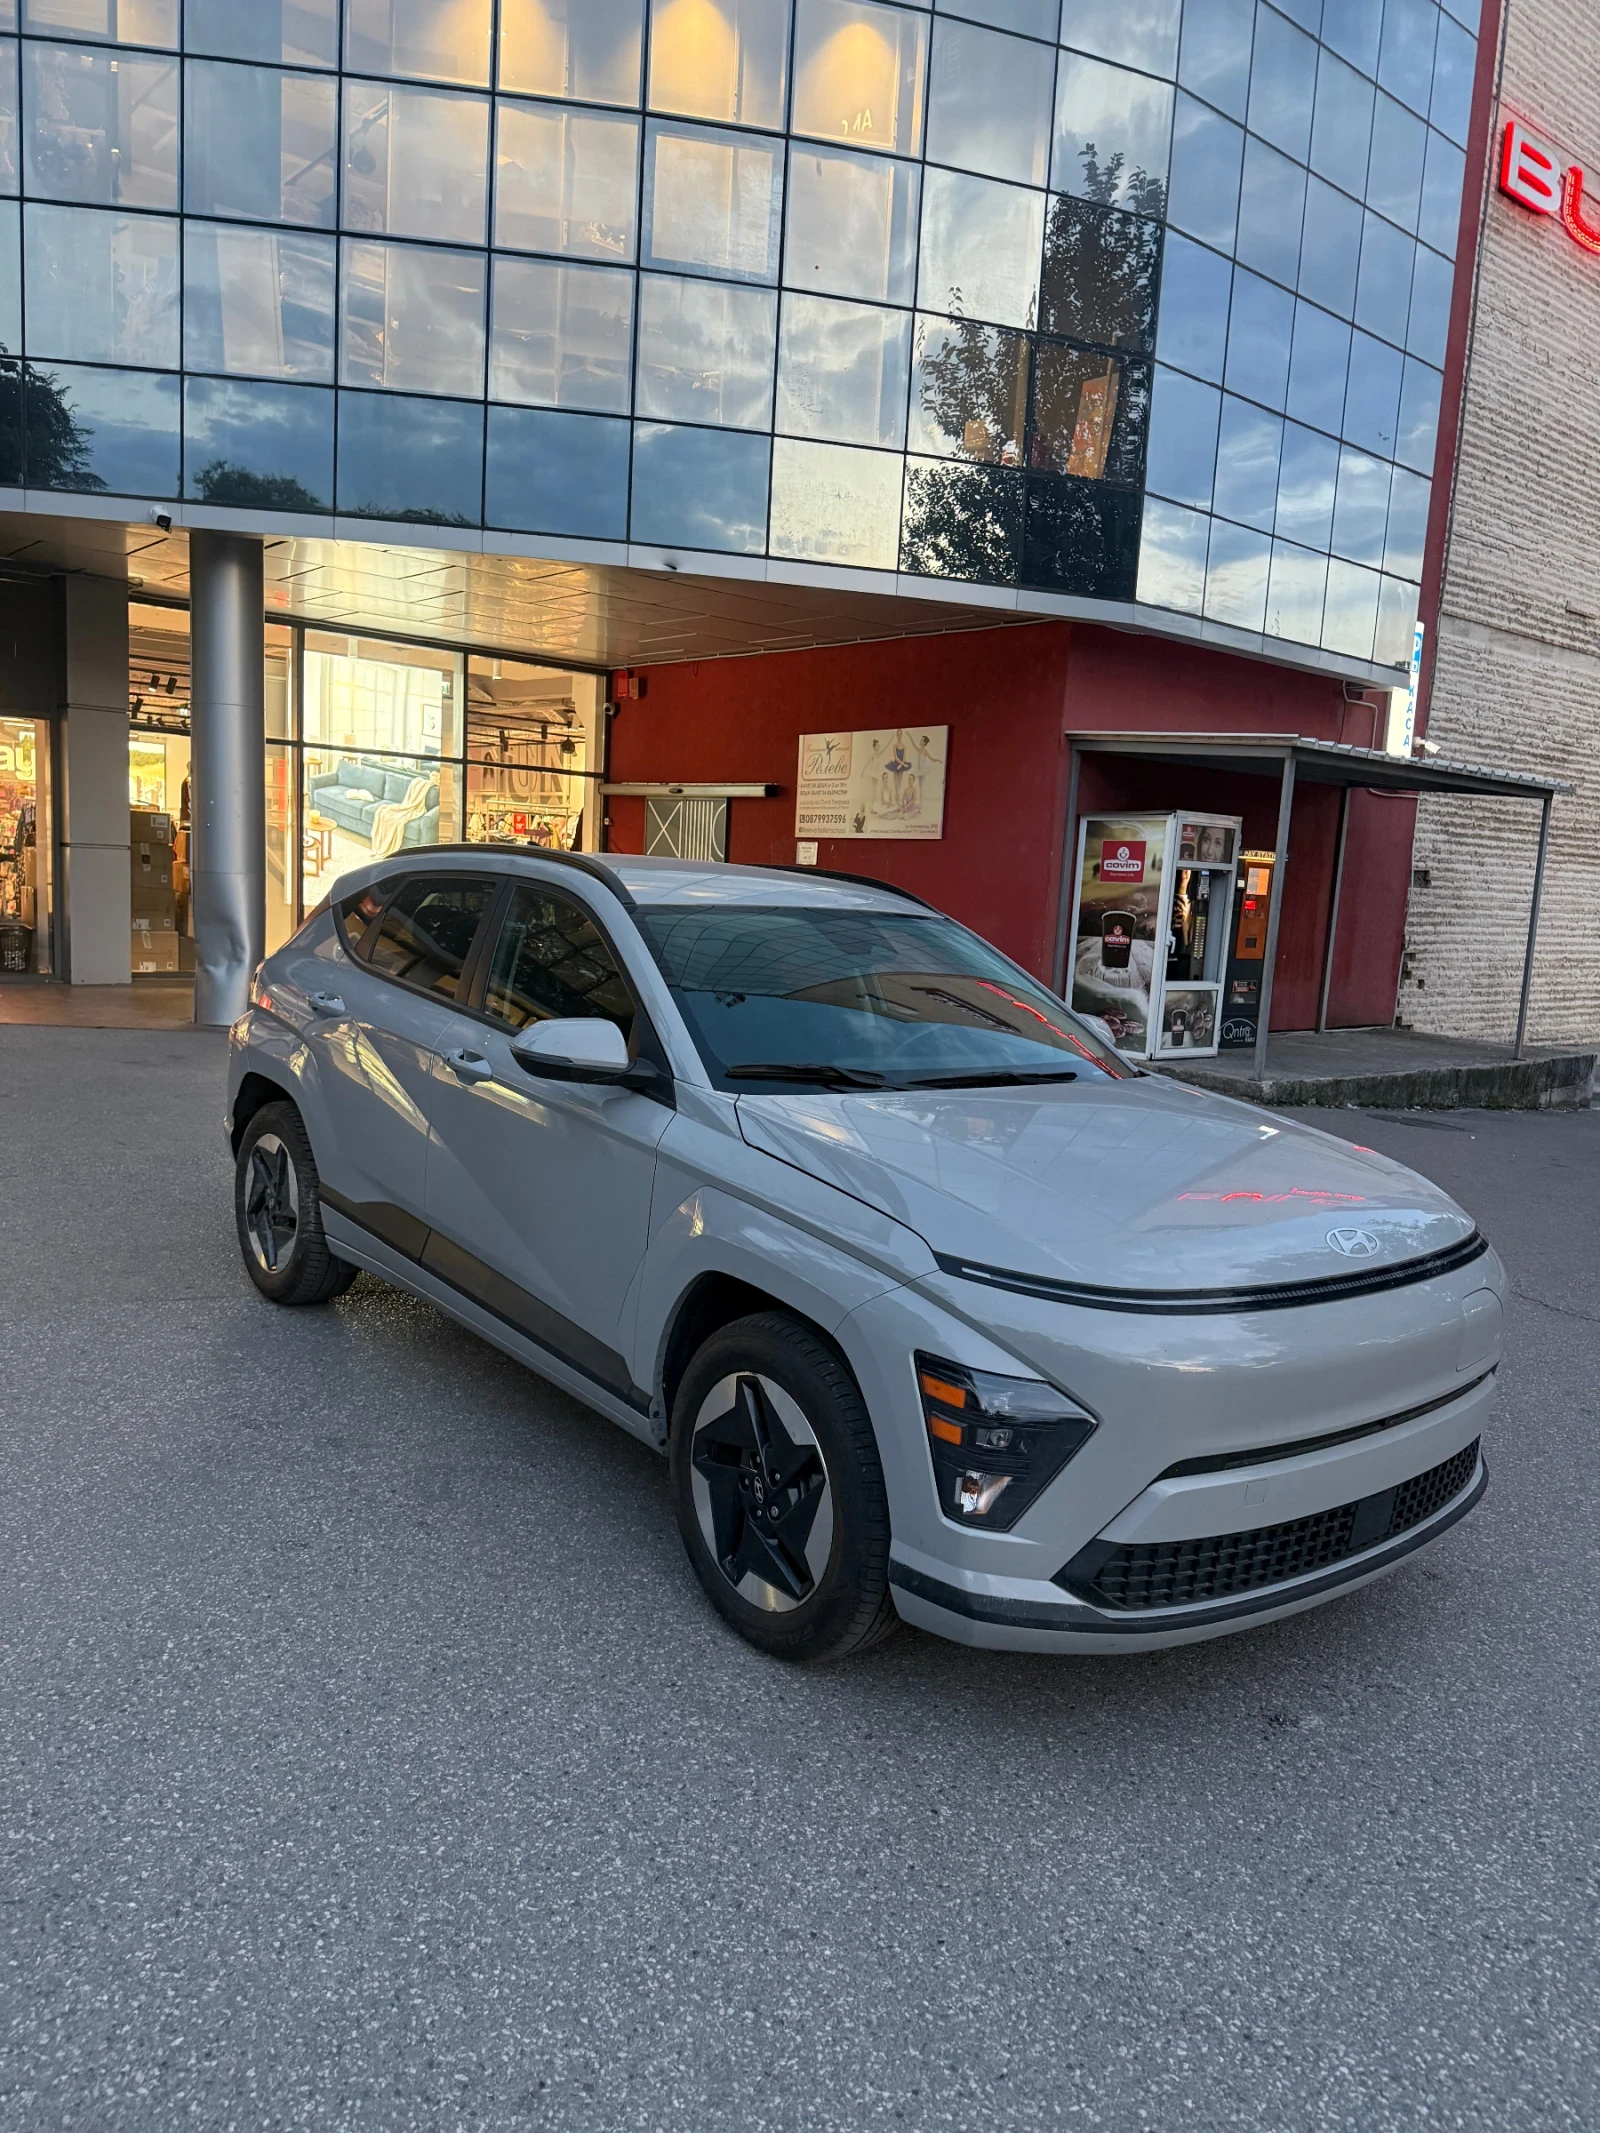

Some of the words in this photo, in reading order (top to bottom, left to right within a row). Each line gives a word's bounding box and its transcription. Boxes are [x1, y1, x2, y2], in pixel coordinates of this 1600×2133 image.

[806, 814, 847, 823] 0879937596
[1257, 851, 1276, 859] STATI
[1106, 861, 1139, 869] covim
[1104, 935, 1130, 943] covim
